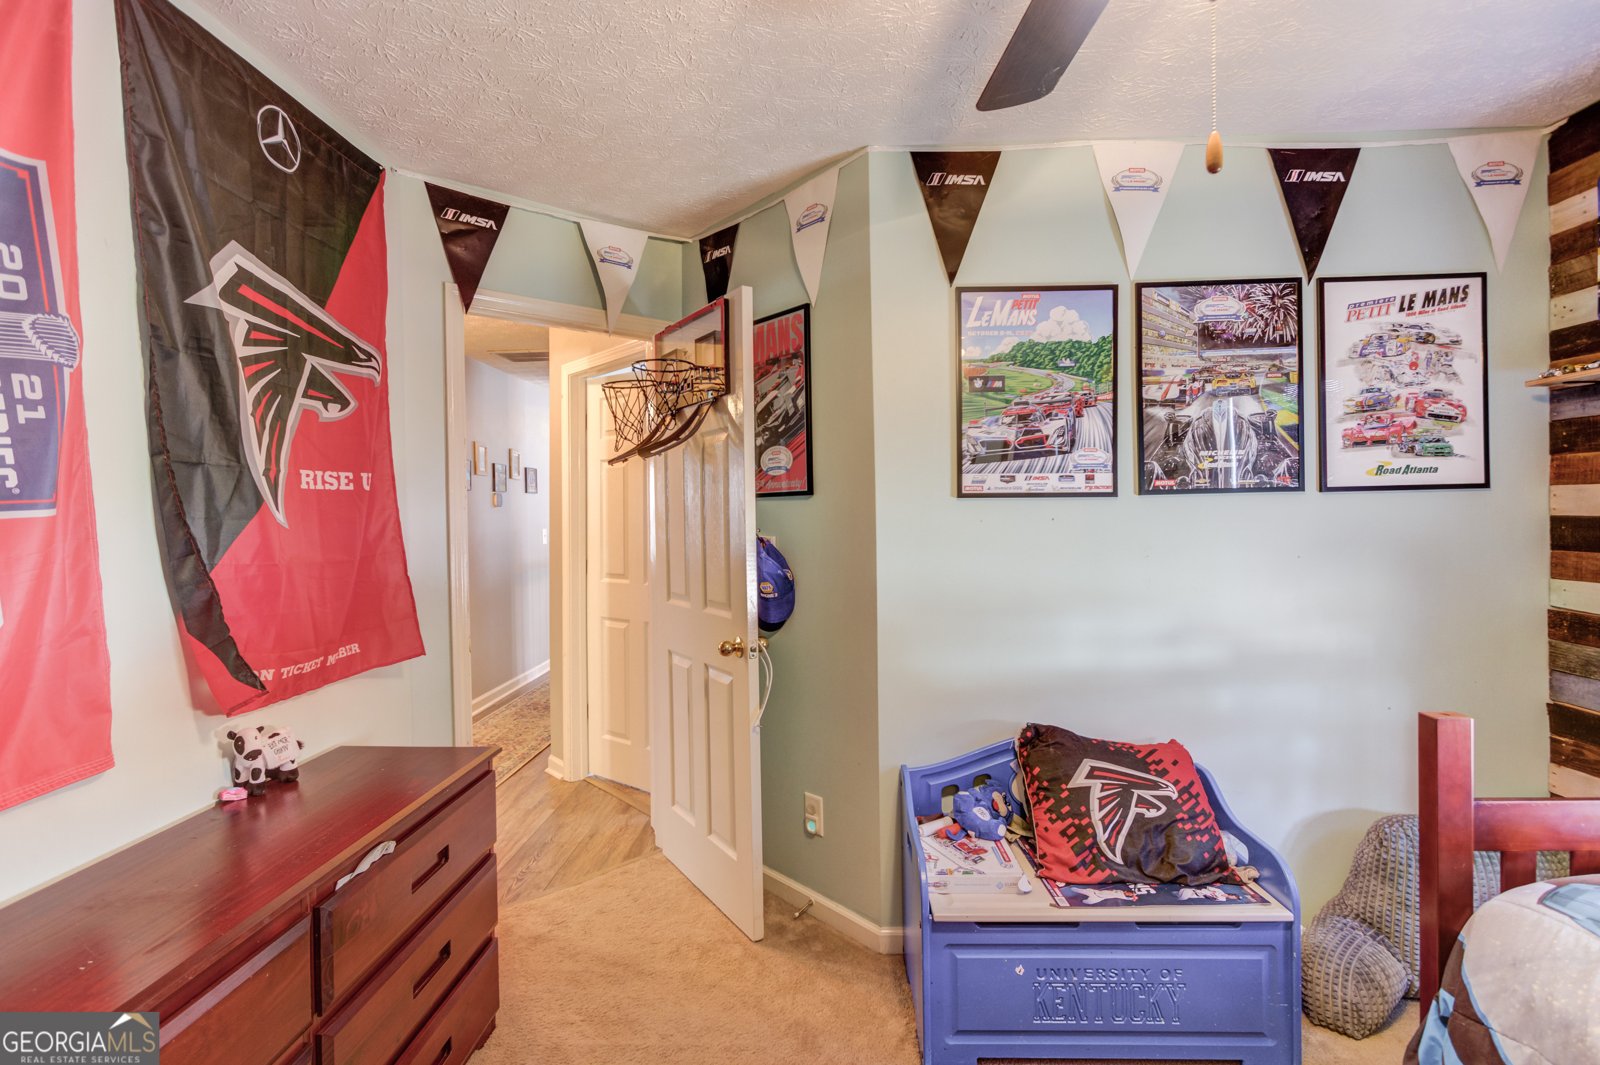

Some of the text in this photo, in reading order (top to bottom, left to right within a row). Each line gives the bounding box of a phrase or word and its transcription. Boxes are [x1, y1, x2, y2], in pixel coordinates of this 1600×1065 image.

[944, 174, 987, 185] IMSA
[1303, 171, 1346, 182] IMSA
[459, 213, 498, 230] IMSA
[712, 245, 732, 260] IMSA
[1010, 299, 1040, 310] PETIT
[1398, 284, 1470, 313] LE MANS
[1344, 303, 1394, 323] PETIT
[10, 372, 47, 427] 21
[1375, 464, 1439, 476] Road Atlanta
[300, 469, 354, 491] RISE
[280, 656, 325, 679] TICKET
[1035, 968, 1184, 981] UNIVERSITY OF
[1032, 983, 1187, 1025] KENTUCKY
